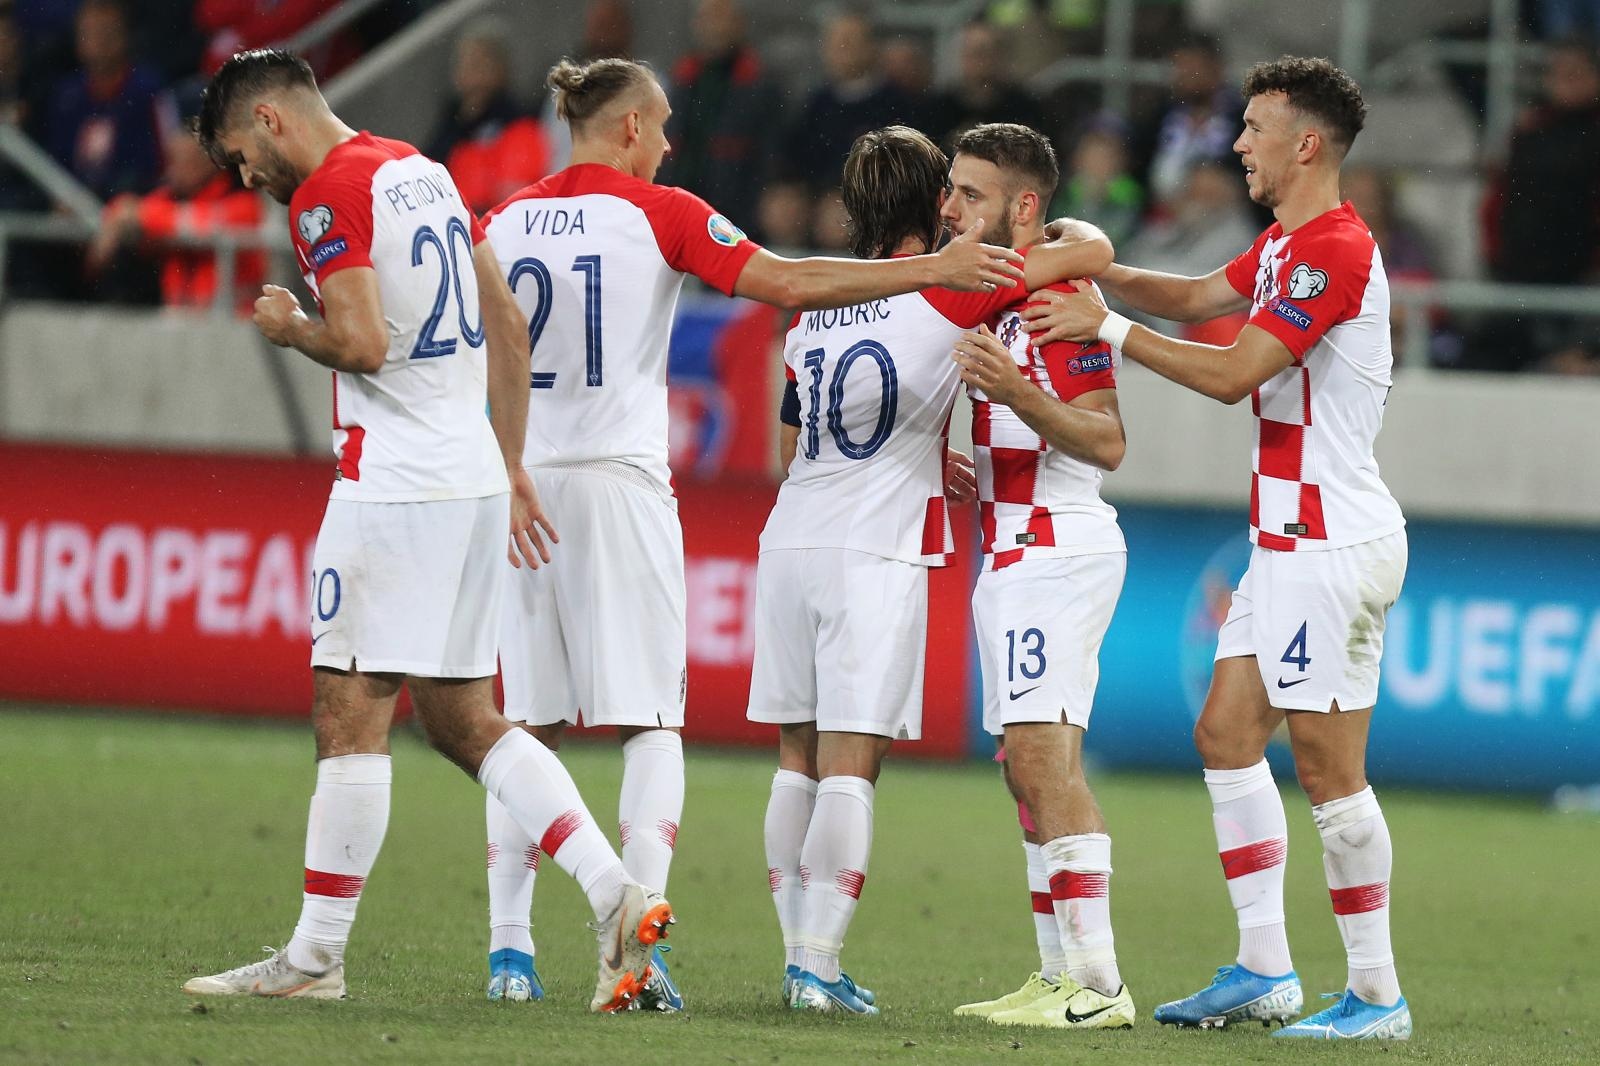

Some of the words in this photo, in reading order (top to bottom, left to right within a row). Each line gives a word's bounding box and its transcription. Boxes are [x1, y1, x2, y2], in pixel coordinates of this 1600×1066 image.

[525, 208, 585, 236] VIDA
[408, 216, 485, 359] 20
[508, 255, 603, 389] 21
[1277, 304, 1311, 327] RESPECT
[1081, 356, 1110, 369] RESPECT
[804, 339, 898, 460] 10
[0, 521, 315, 641] UROPEA
[311, 567, 341, 622] 0
[1005, 627, 1047, 682] 13
[1280, 620, 1312, 672] 4
